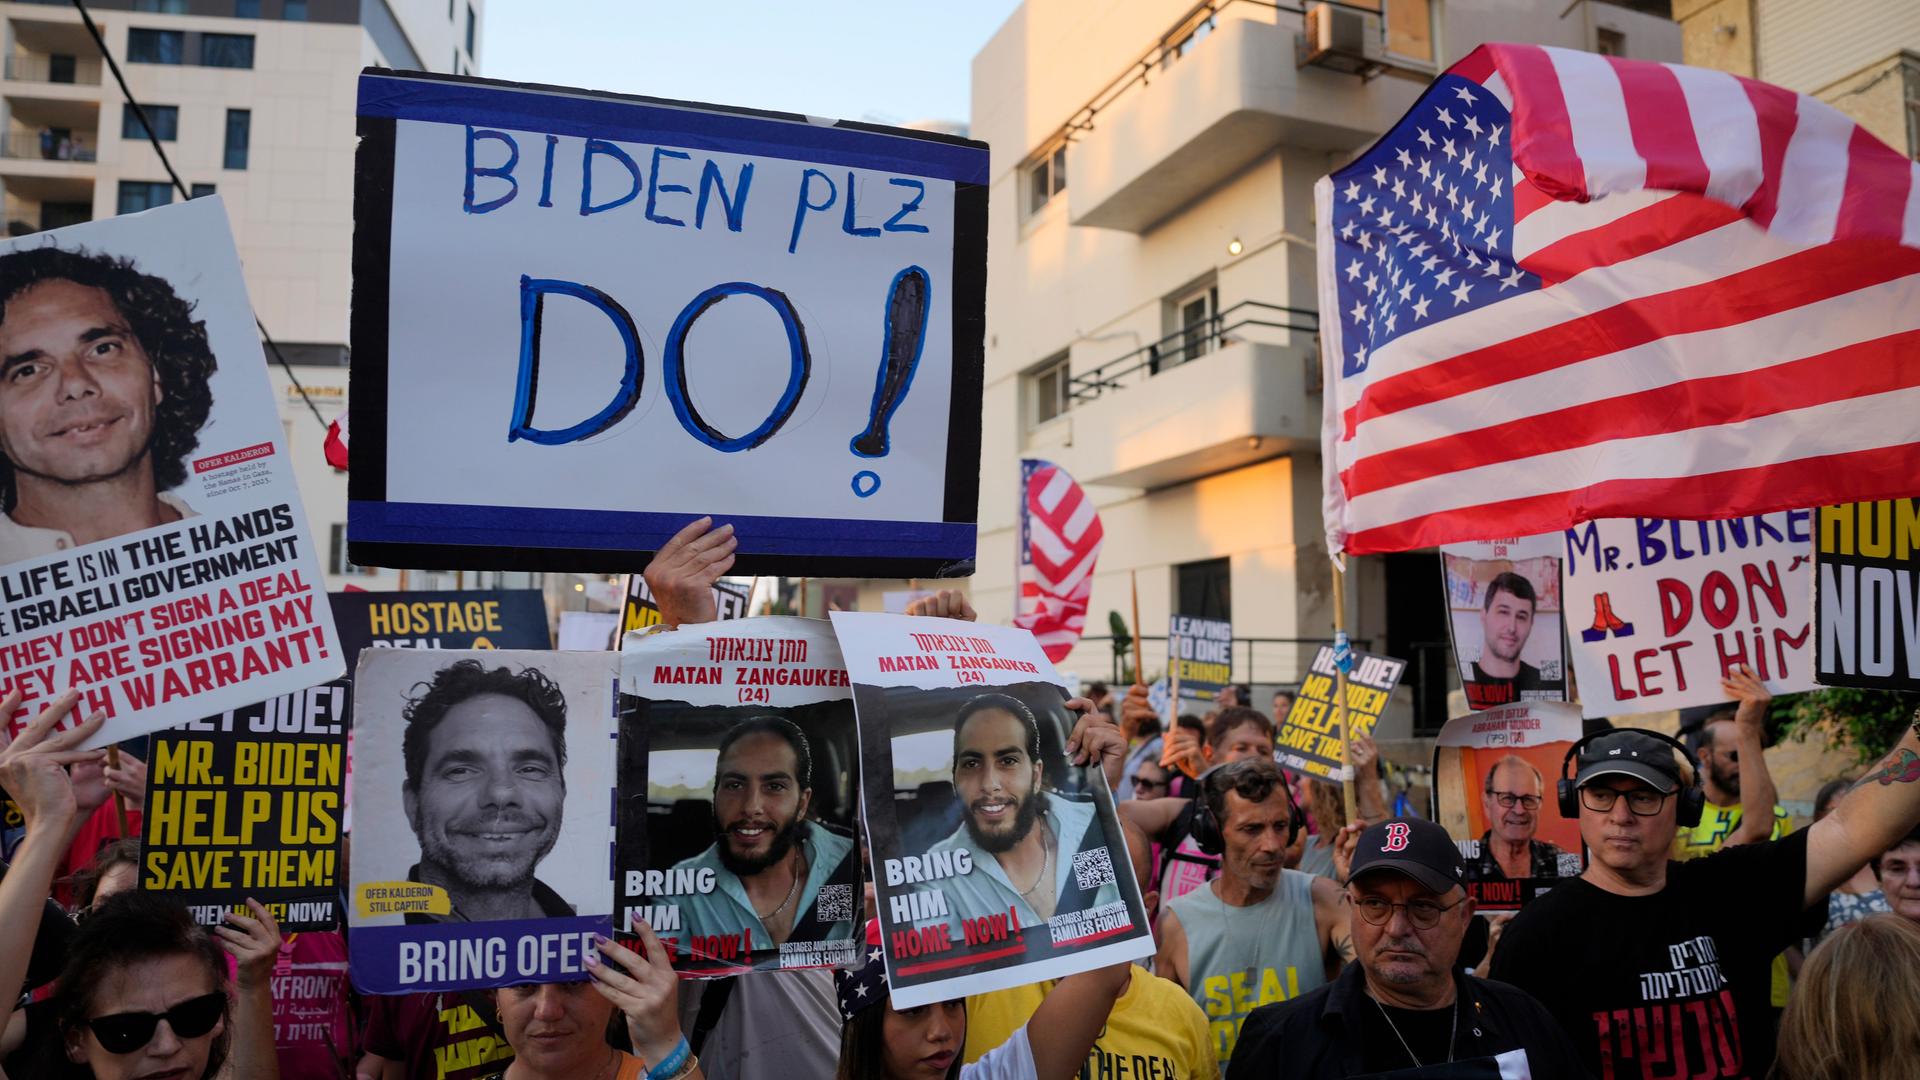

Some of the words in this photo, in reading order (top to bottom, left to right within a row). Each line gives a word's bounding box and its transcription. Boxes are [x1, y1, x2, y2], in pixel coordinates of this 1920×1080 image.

[464, 124, 754, 232] BIDEN
[789, 168, 929, 254] PLZ
[508, 265, 931, 498] DO!
[198, 457, 222, 470] OFER
[223, 446, 271, 464] KALDERON
[208, 467, 238, 481] hostage
[239, 463, 257, 474] held
[257, 462, 267, 472] by
[204, 482, 217, 490] the
[218, 476, 241, 487] Hamas
[206, 487, 227, 498] since
[228, 484, 241, 494] Oct
[0, 560, 73, 603] LIFE
[77, 553, 97, 584] IS
[99, 548, 120, 578] IN
[122, 531, 186, 571] THE
[189, 503, 295, 554] HANDS
[12, 582, 120, 634] ISRAELI
[123, 534, 298, 604] GOVERNMENT
[69, 610, 146, 653] DON'T
[151, 592, 212, 631] SIGN
[218, 588, 238, 614] A
[239, 568, 311, 608] DEAL
[369, 600, 502, 636] HOSTAGE
[69, 645, 136, 688] ARE
[138, 609, 266, 669] SIGNING
[269, 594, 314, 632] MY
[910, 633, 970, 653] צנגאוקר
[1170, 616, 1232, 641] LEAVING
[706, 637, 774, 664] צנגאוקר
[778, 638, 808, 664] מתן
[967, 637, 997, 655] מתן
[1195, 639, 1231, 664] ONE
[121, 626, 329, 713] WARRANT!
[653, 665, 722, 686] MATAN
[735, 668, 851, 688] ZANGAUKER
[878, 655, 940, 673] MATAN
[946, 655, 1040, 674] ZANGAUKER
[956, 670, 985, 684] (24)
[1348, 655, 1402, 689] JOE!
[1608, 641, 1693, 701] LET
[738, 688, 770, 704] (24)
[1299, 673, 1333, 702] MR.
[249, 686, 345, 735] JOE!
[1276, 724, 1320, 753] SAVE
[153, 740, 224, 785] MR.
[233, 741, 342, 786] BIDEN
[148, 790, 271, 846] HELP
[280, 791, 339, 845] US
[1380, 822, 1412, 852] B
[145, 850, 234, 891] SAVE
[239, 849, 335, 888] THEM!
[624, 867, 717, 897] BRING
[884, 848, 973, 888] BRING
[366, 888, 388, 900] OFER
[389, 886, 434, 899] KALDERON
[1482, 879, 1521, 902] NOW!
[288, 901, 333, 923] NOW!
[369, 901, 392, 913] STILL
[394, 900, 430, 912] CAPTIVE
[889, 889, 949, 924] HIM
[1047, 911, 1082, 928] HOSTAGES
[891, 922, 952, 960] HOME
[961, 905, 1024, 947] NOW!
[1050, 919, 1096, 944] FAMILIES
[1094, 910, 1132, 934] FORUM
[690, 927, 753, 964] NOW!
[779, 940, 812, 952] HOSTAGES
[779, 952, 823, 969] FAMILIES
[824, 949, 858, 966] FORUM
[399, 936, 506, 985] BRING
